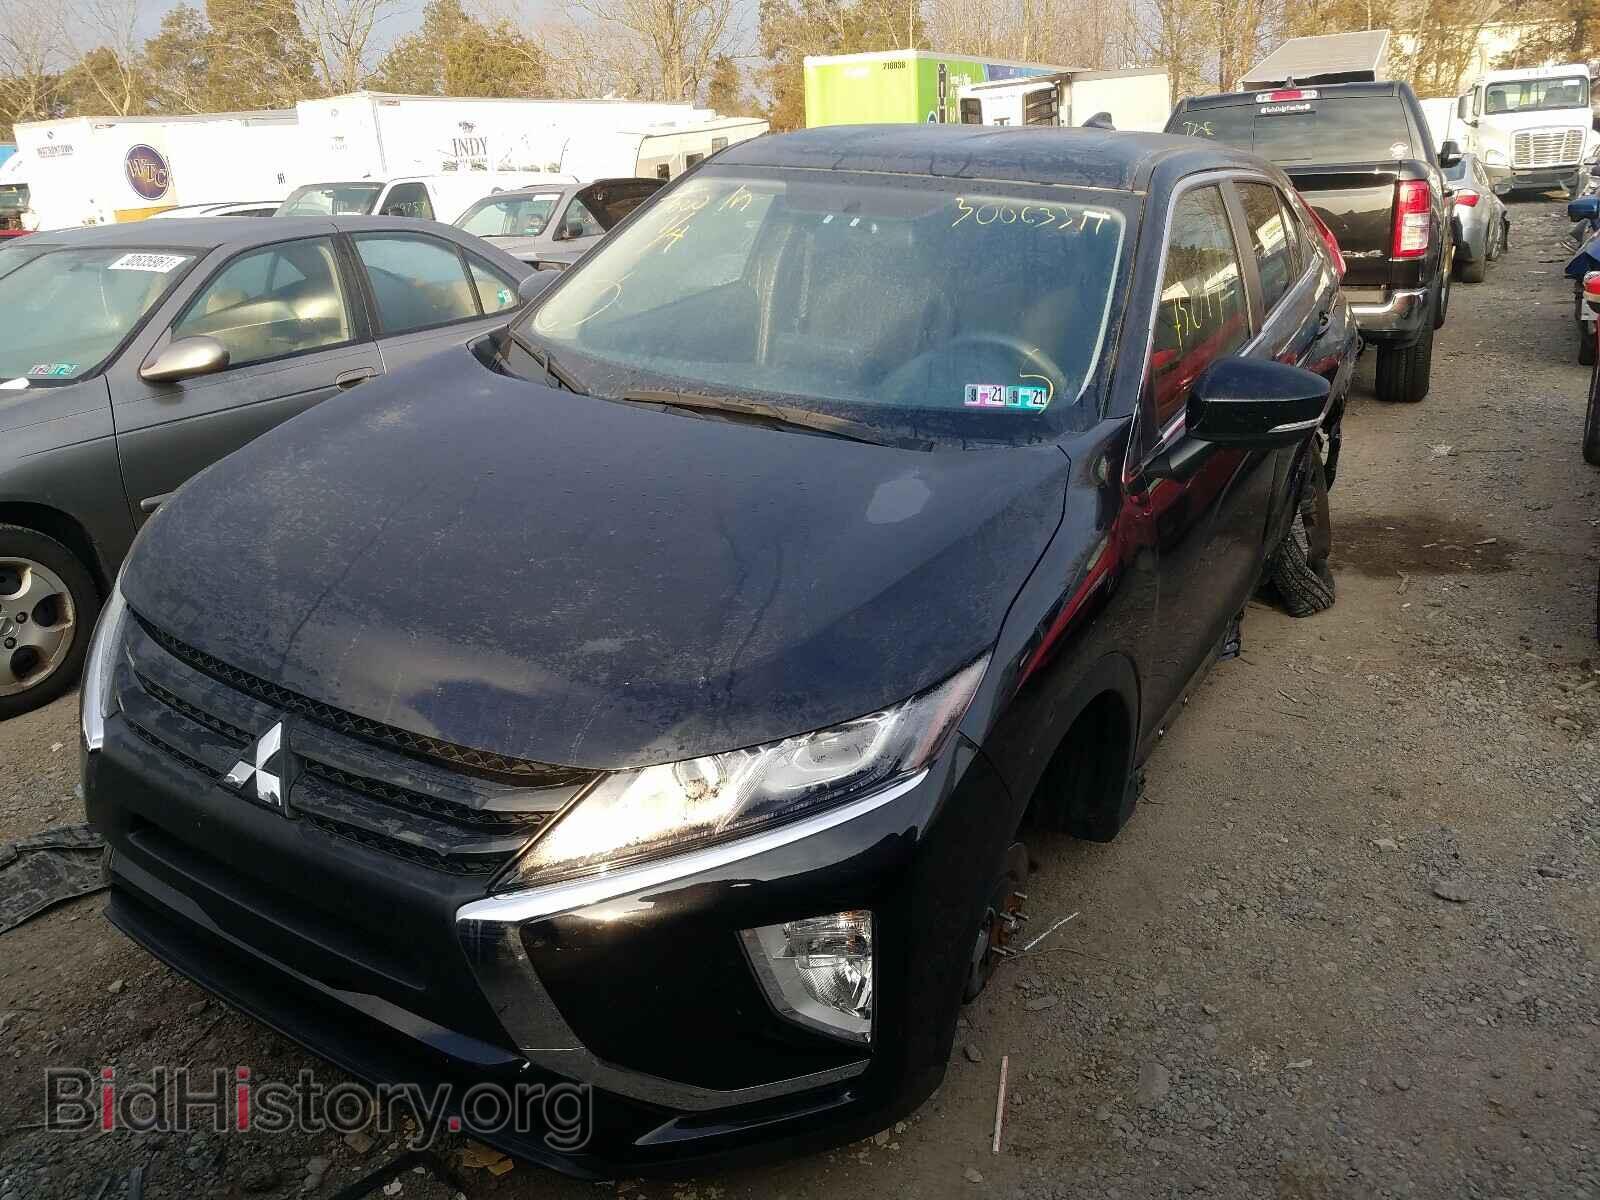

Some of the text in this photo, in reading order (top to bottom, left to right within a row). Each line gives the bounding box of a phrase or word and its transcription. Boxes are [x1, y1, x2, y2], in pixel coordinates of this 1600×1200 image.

[452, 137, 487, 157] INDY
[128, 159, 167, 188] WTC
[992, 386, 1003, 402] 21
[1033, 390, 1045, 405] 21
